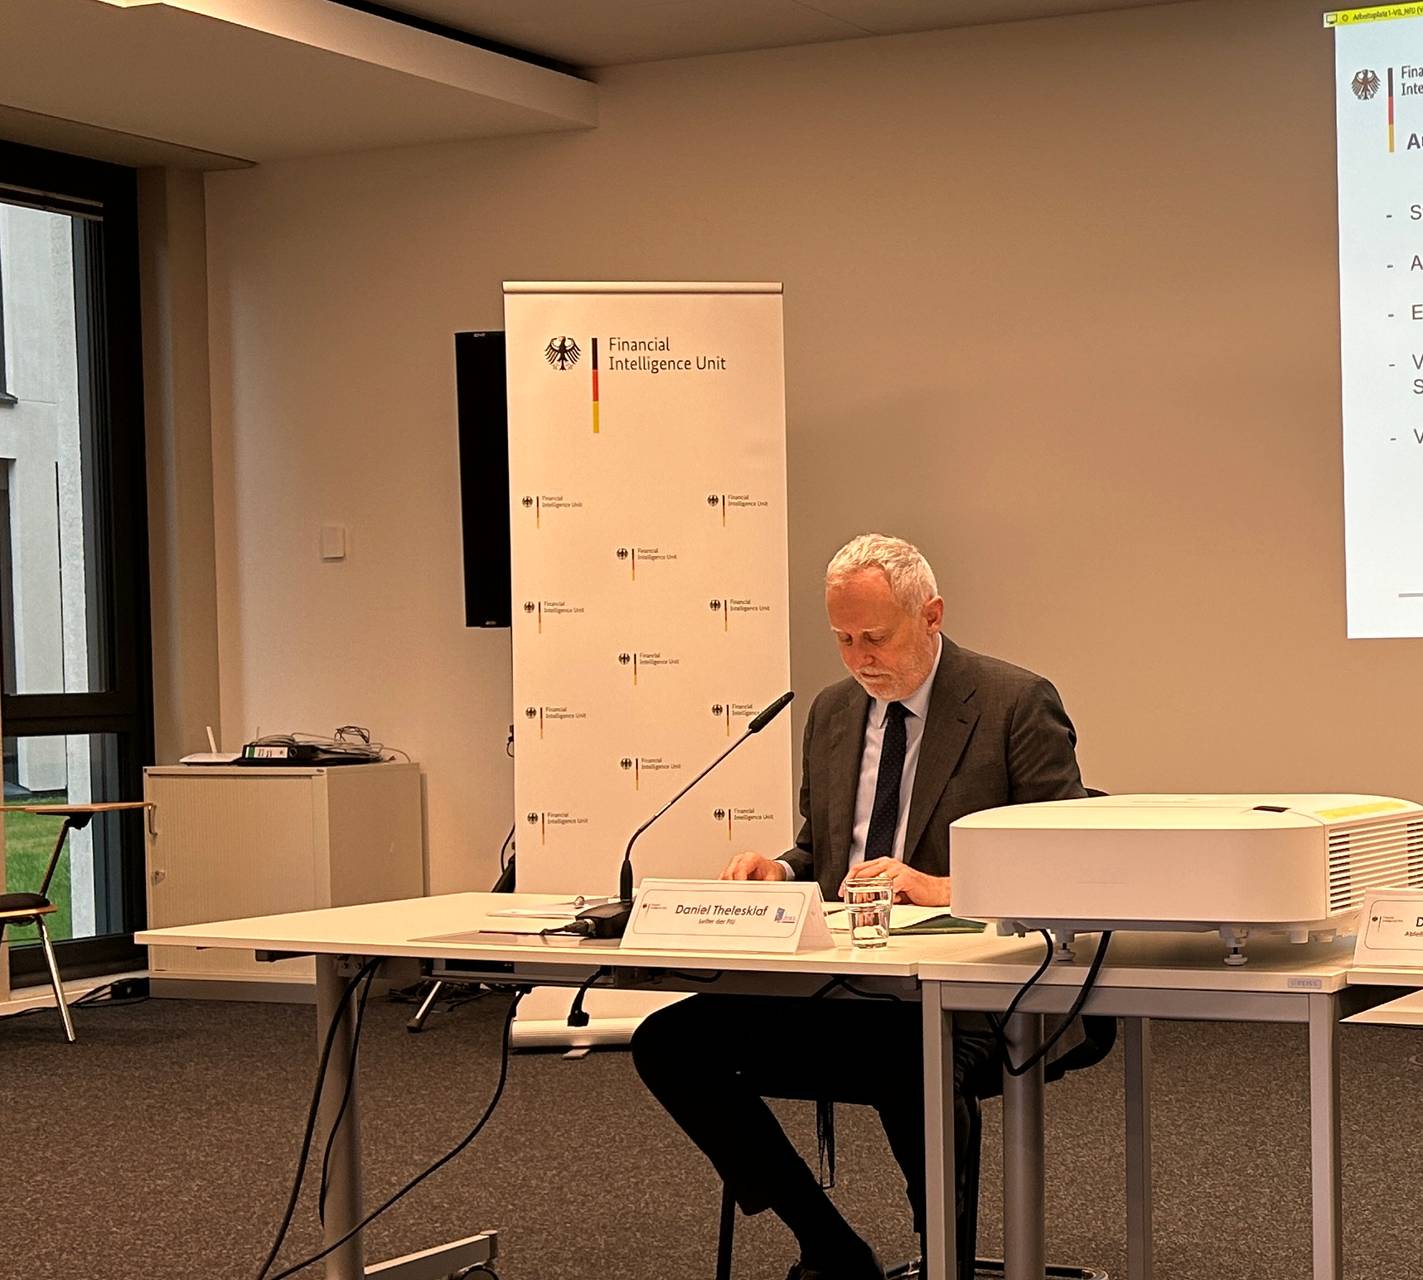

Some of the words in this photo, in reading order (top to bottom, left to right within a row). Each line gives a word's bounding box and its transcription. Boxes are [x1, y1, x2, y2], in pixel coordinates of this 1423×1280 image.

[609, 335, 671, 352] Financial
[608, 355, 692, 375] Intelligence
[695, 355, 727, 371] Unit
[675, 904, 711, 915] Daniel
[713, 904, 768, 916] Thelesklaf
